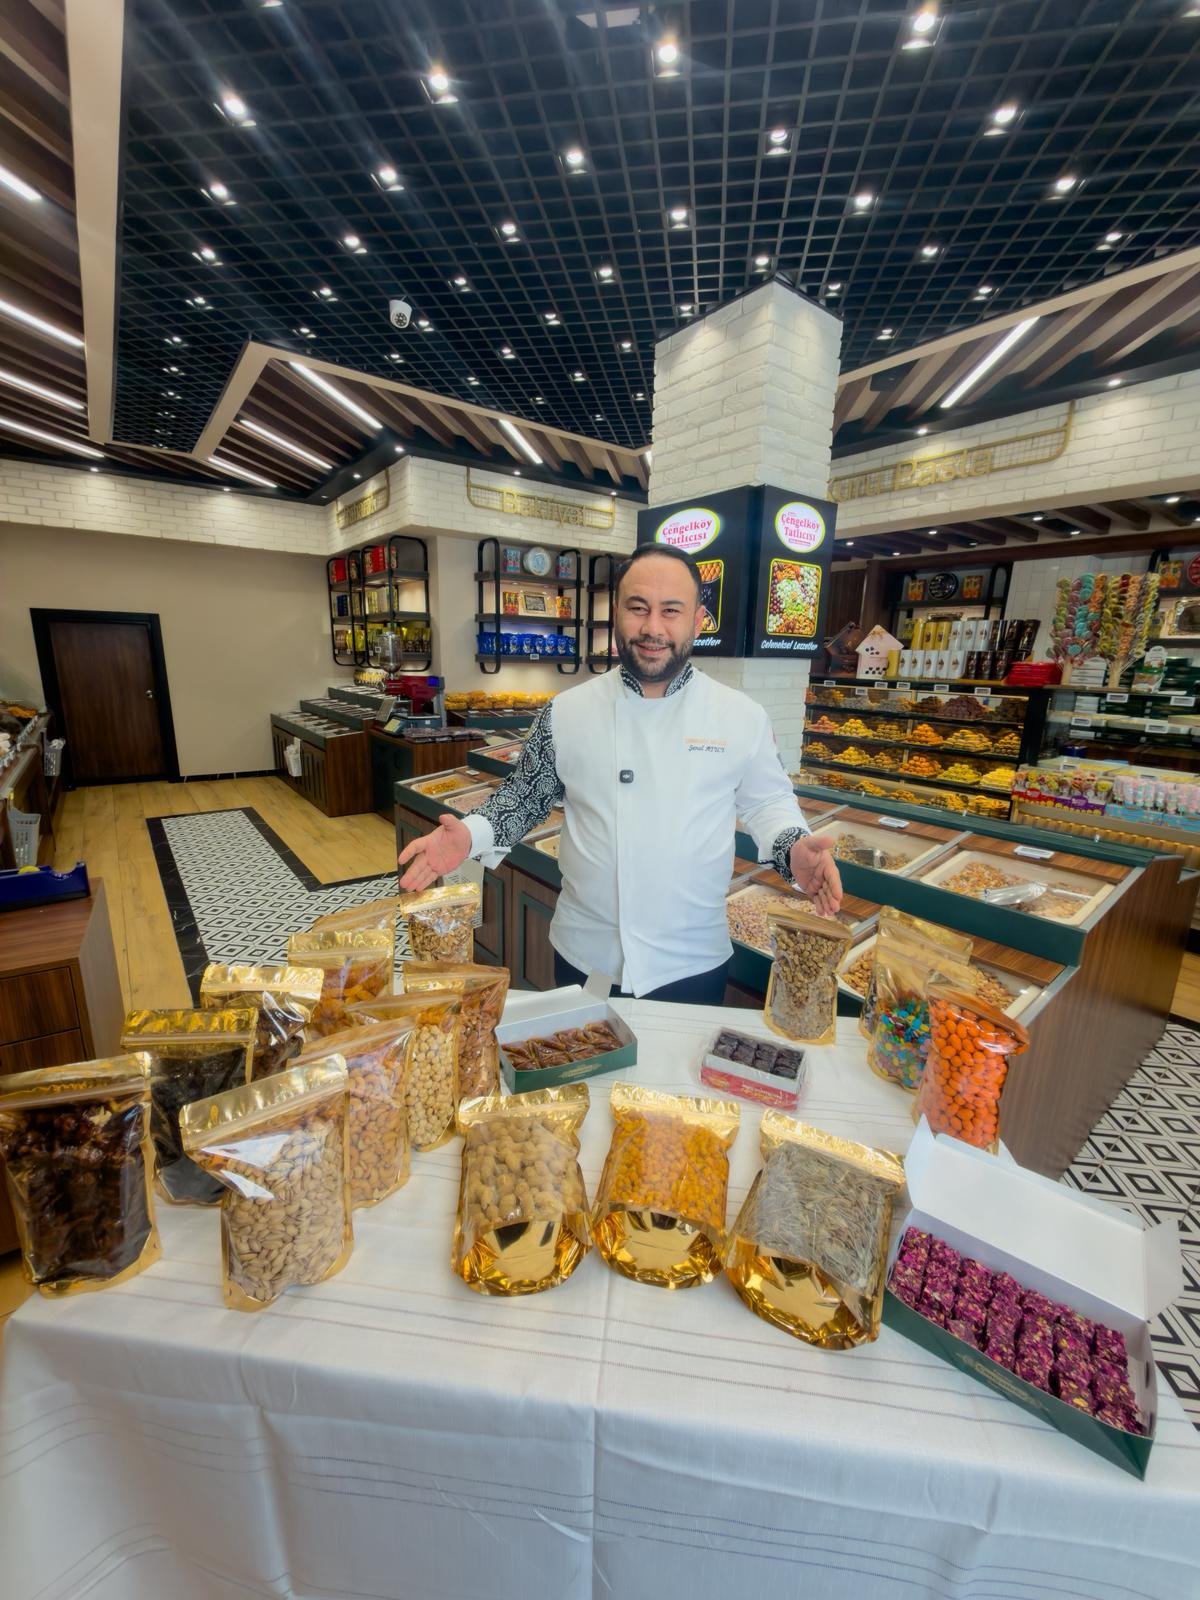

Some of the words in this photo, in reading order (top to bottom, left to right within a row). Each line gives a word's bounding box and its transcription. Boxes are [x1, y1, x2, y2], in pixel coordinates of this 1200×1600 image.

[894, 448, 993, 490] Pasta
[662, 519, 713, 538] Çengelköy
[781, 513, 820, 533] Çengelköy
